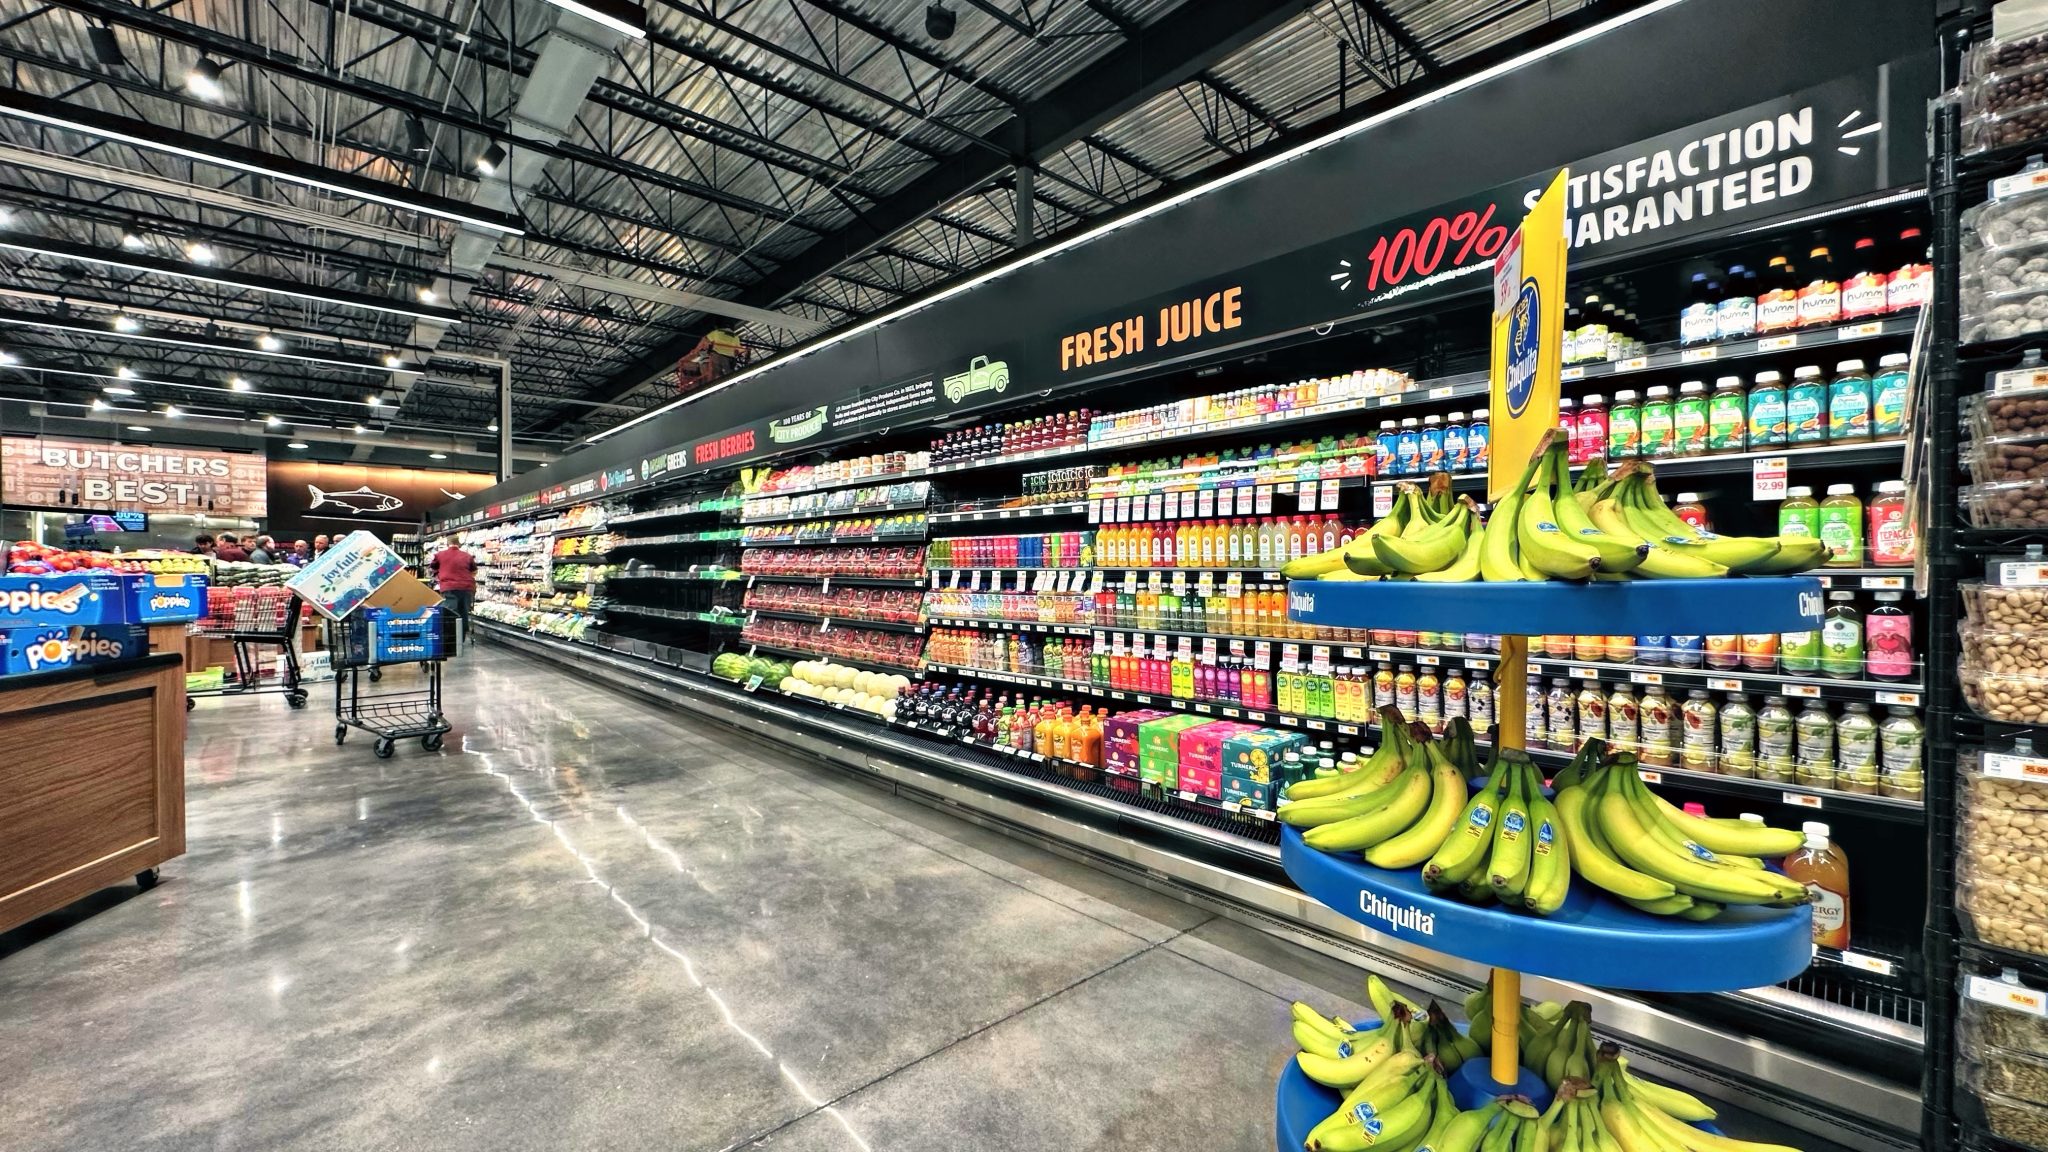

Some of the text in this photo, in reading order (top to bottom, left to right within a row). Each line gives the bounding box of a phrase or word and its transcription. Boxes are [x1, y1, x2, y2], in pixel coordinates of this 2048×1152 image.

[1523, 106, 1813, 211] STISFACTION
[1565, 155, 1813, 250] UARANTEED
[1367, 203, 1508, 292] 100%
[1802, 296, 1836, 309] humm
[1846, 289, 1883, 303] humm
[1719, 310, 1750, 322] humm
[1762, 304, 1795, 316] humm
[1061, 286, 1242, 371] FRESH JUICE
[1684, 316, 1715, 327] humm
[1506, 345, 1538, 393] Chiquita
[791, 413, 805, 423] YEARS
[805, 410, 812, 419] OF
[776, 429, 791, 441] CITY
[791, 420, 820, 438] PRODUCE
[695, 430, 755, 465] FRESH BERRIES
[41, 447, 231, 477] BUTCHERS
[667, 449, 687, 471] GREENS
[83, 478, 195, 506] BEST
[1756, 480, 1784, 491] $2.99
[150, 592, 191, 612] poppies
[1291, 589, 1315, 617] Chiquita
[26, 631, 123, 670] poppies
[1110, 736, 1131, 746] TURMERIC
[1146, 743, 1169, 753] TURMERIC
[1106, 758, 1125, 768] TURMERIC
[1188, 752, 1214, 762] TURMERIC
[1231, 762, 1258, 772] TURMERIC
[1181, 777, 1203, 786] TURMERIC
[1224, 787, 1249, 797] TURMERIC
[1360, 889, 1435, 936] Chiquita
[1813, 905, 1840, 916] ERGY
